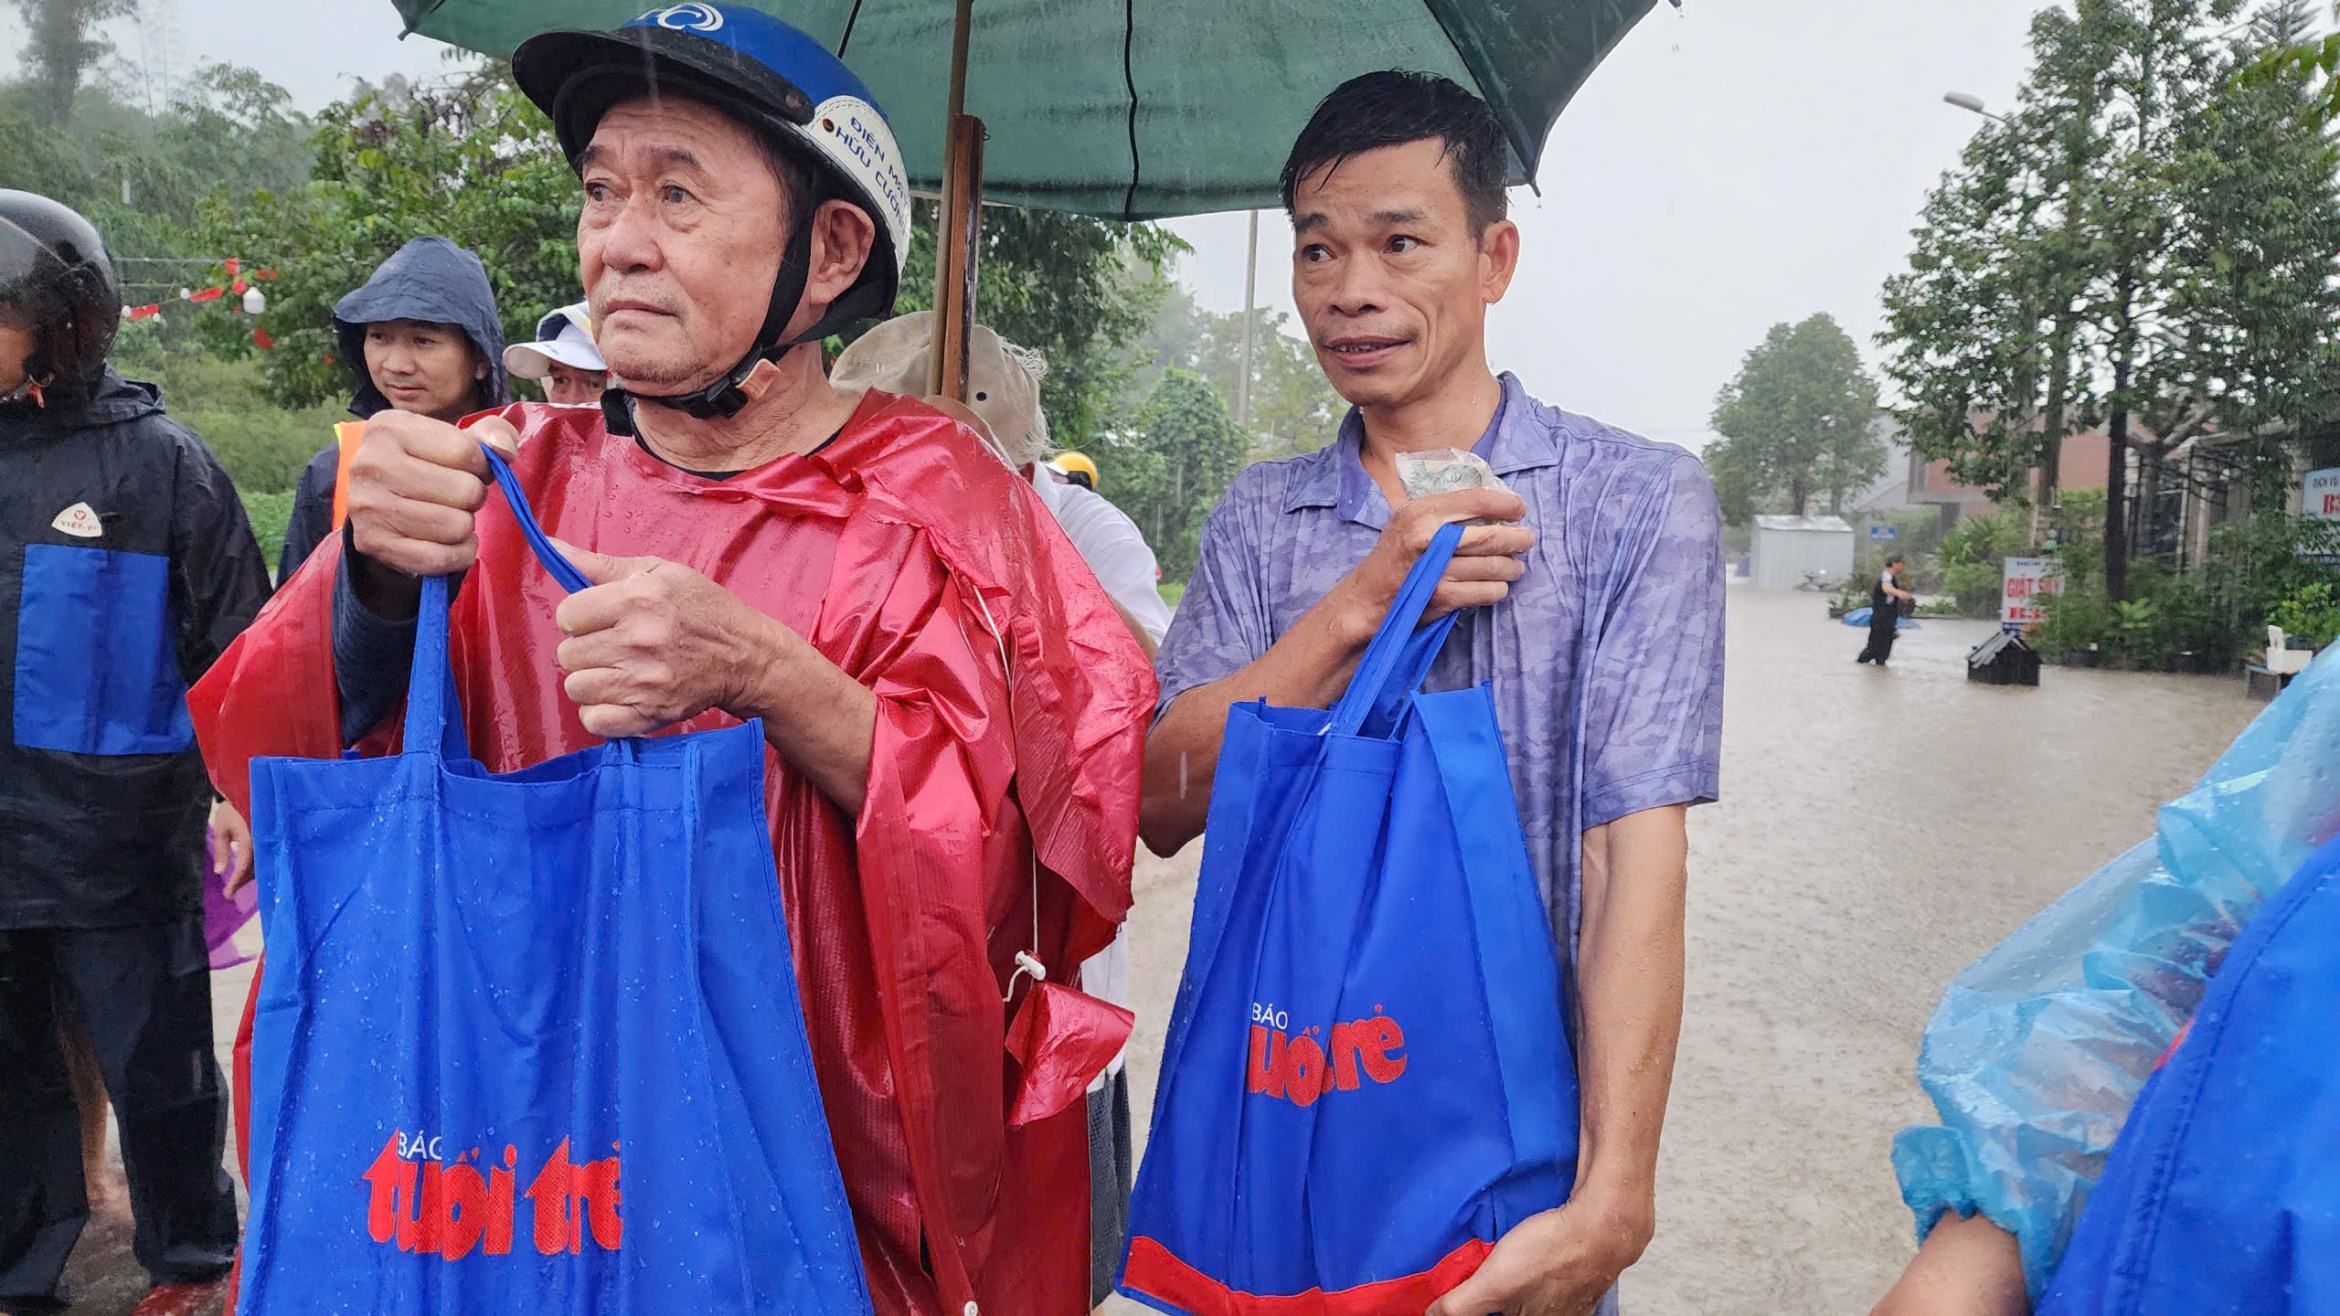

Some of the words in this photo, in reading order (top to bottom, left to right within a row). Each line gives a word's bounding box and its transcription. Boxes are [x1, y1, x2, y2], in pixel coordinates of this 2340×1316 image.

[835, 125, 871, 168] HỮU
[850, 116, 886, 162] ĐIỆN
[1252, 1002, 1289, 1031] BÁO
[1248, 1024, 1326, 1108] uổ
[1321, 1003, 1408, 1095] rẻ
[362, 1126, 515, 1261] tuổi
